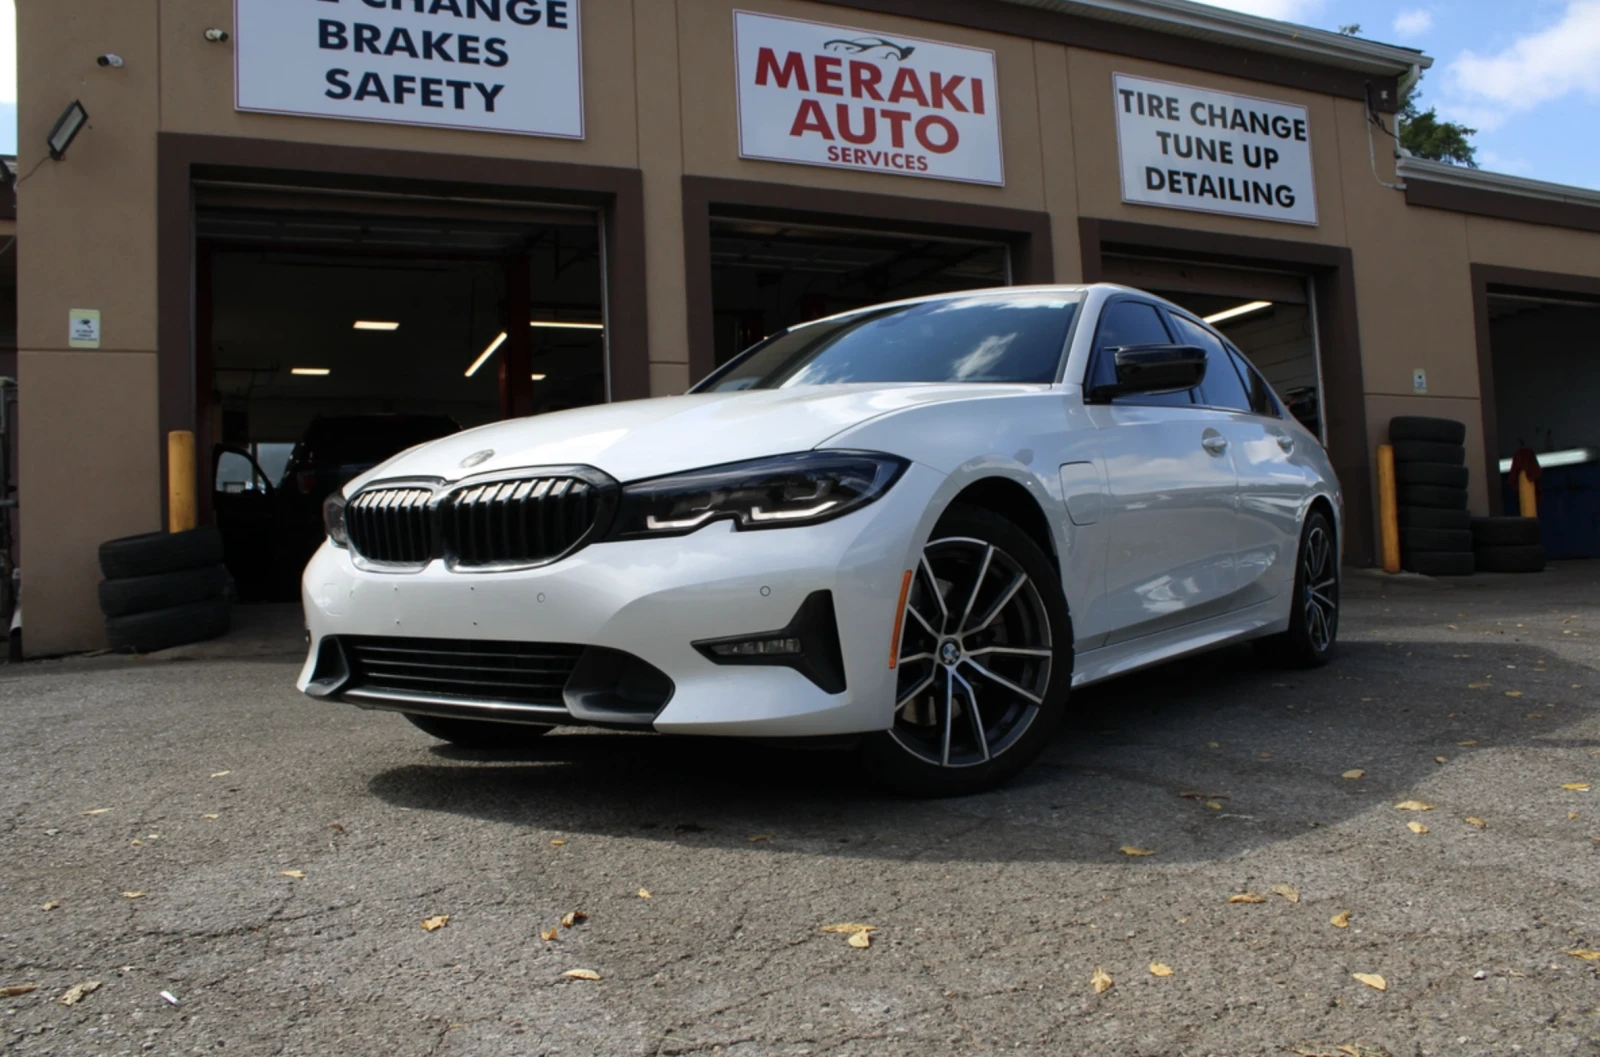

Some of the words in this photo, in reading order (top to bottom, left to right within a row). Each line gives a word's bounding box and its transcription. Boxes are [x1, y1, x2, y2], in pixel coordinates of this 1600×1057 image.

[318, 18, 510, 67] BRAKES
[324, 68, 505, 113] SAFETY
[754, 46, 985, 115] MERAKI
[789, 98, 959, 154] AUTO
[1118, 88, 1180, 121] TIRE
[1190, 101, 1307, 142] CHANGE
[827, 145, 928, 171] SERVICES
[1156, 130, 1233, 164] TUNE
[1242, 144, 1279, 170] UP
[1145, 166, 1295, 208] DETAILING
